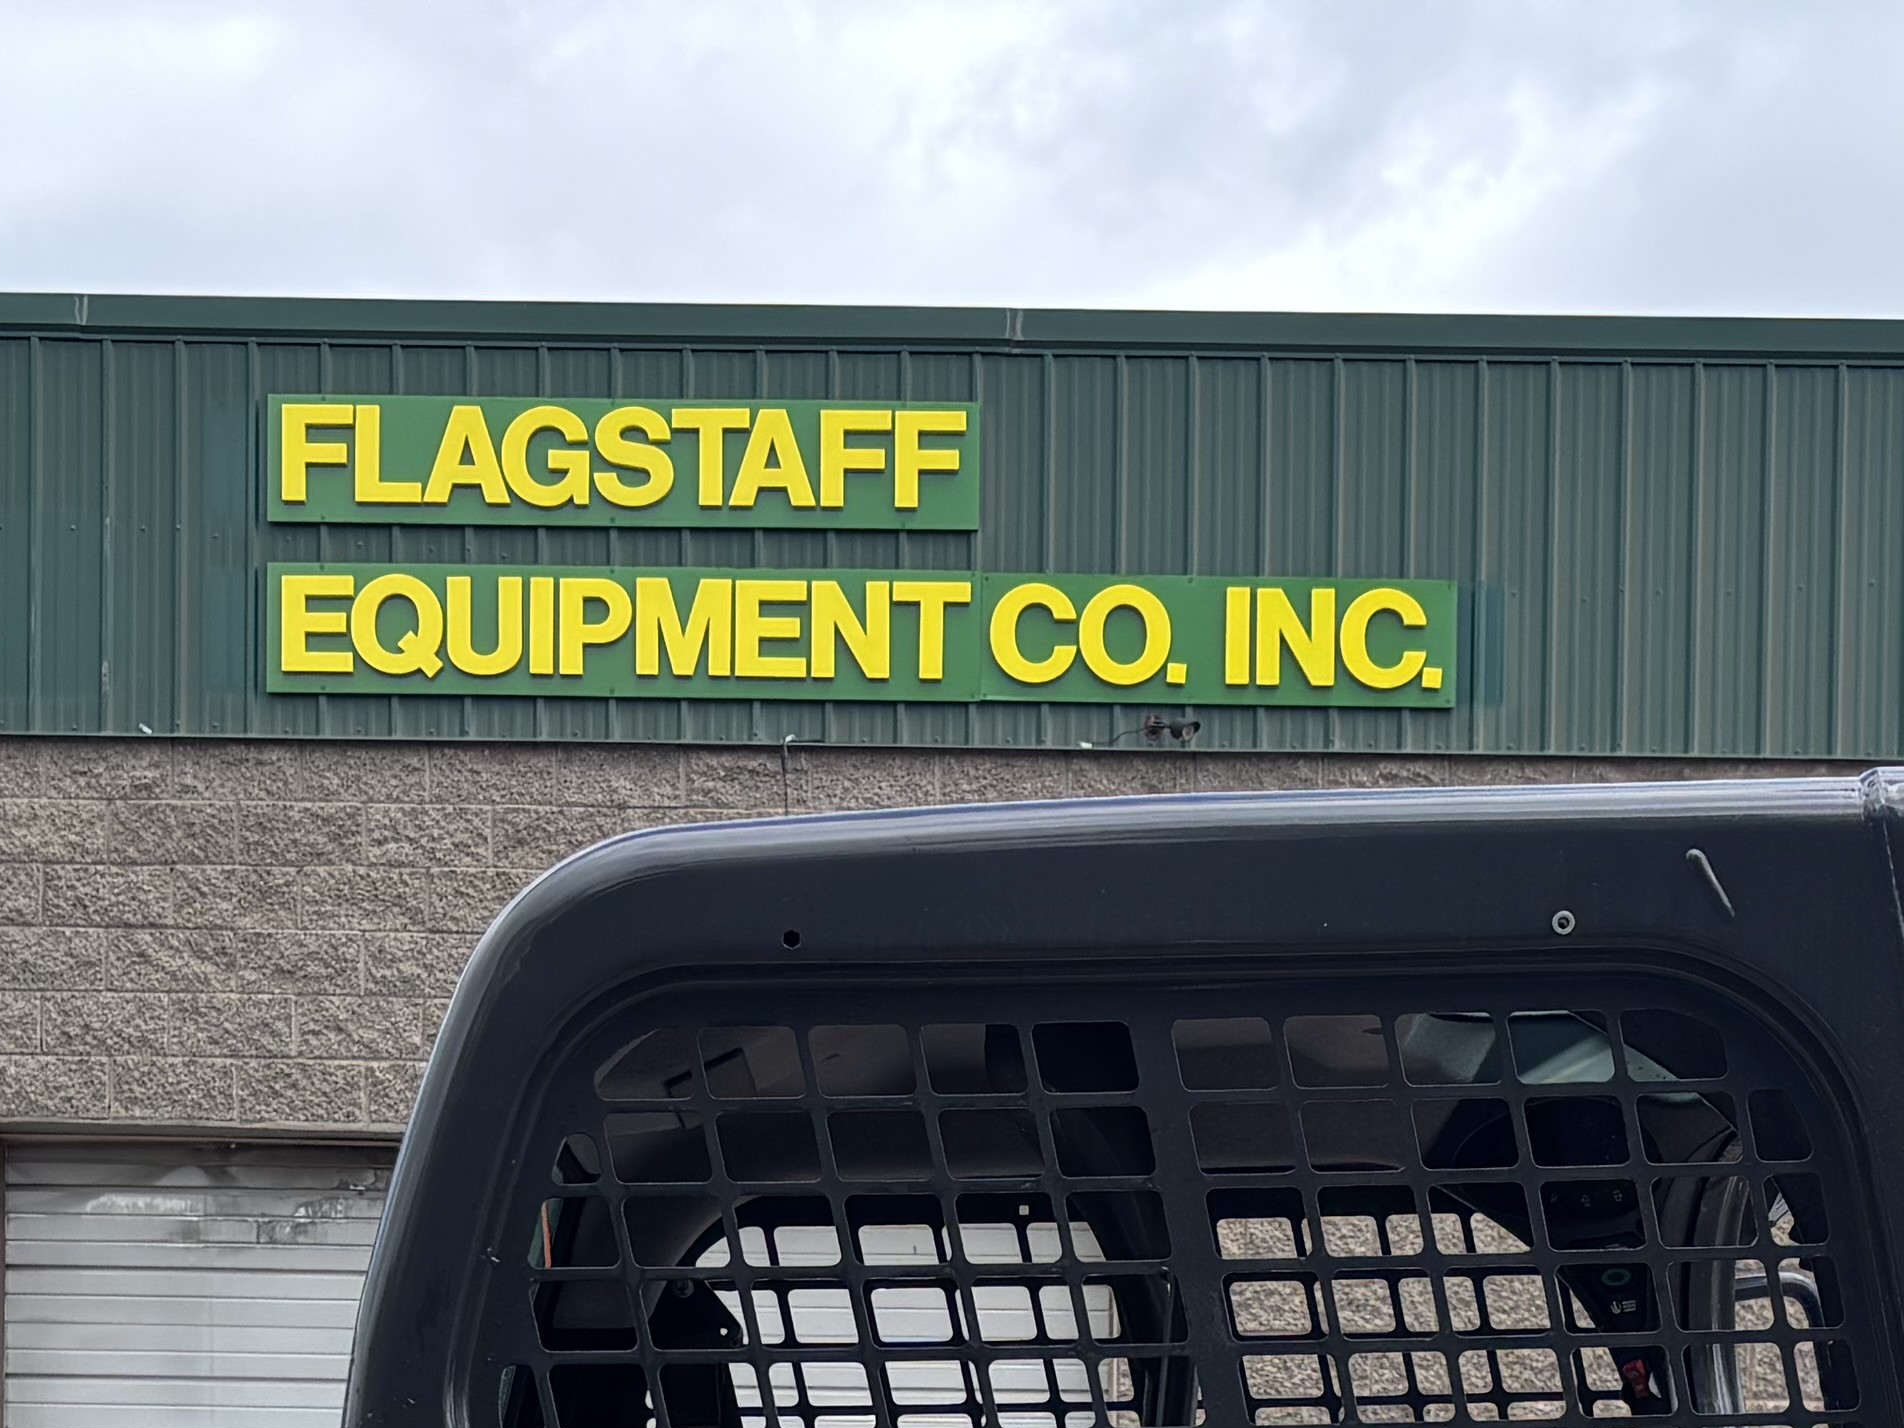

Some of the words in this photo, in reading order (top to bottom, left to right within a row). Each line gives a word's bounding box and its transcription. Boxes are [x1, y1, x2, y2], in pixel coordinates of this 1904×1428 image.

[282, 405, 967, 508] FLAGSTAFF
[282, 575, 972, 680] EQUIPMENT
[991, 583, 1187, 686] CO.
[1225, 587, 1443, 689] INC.
